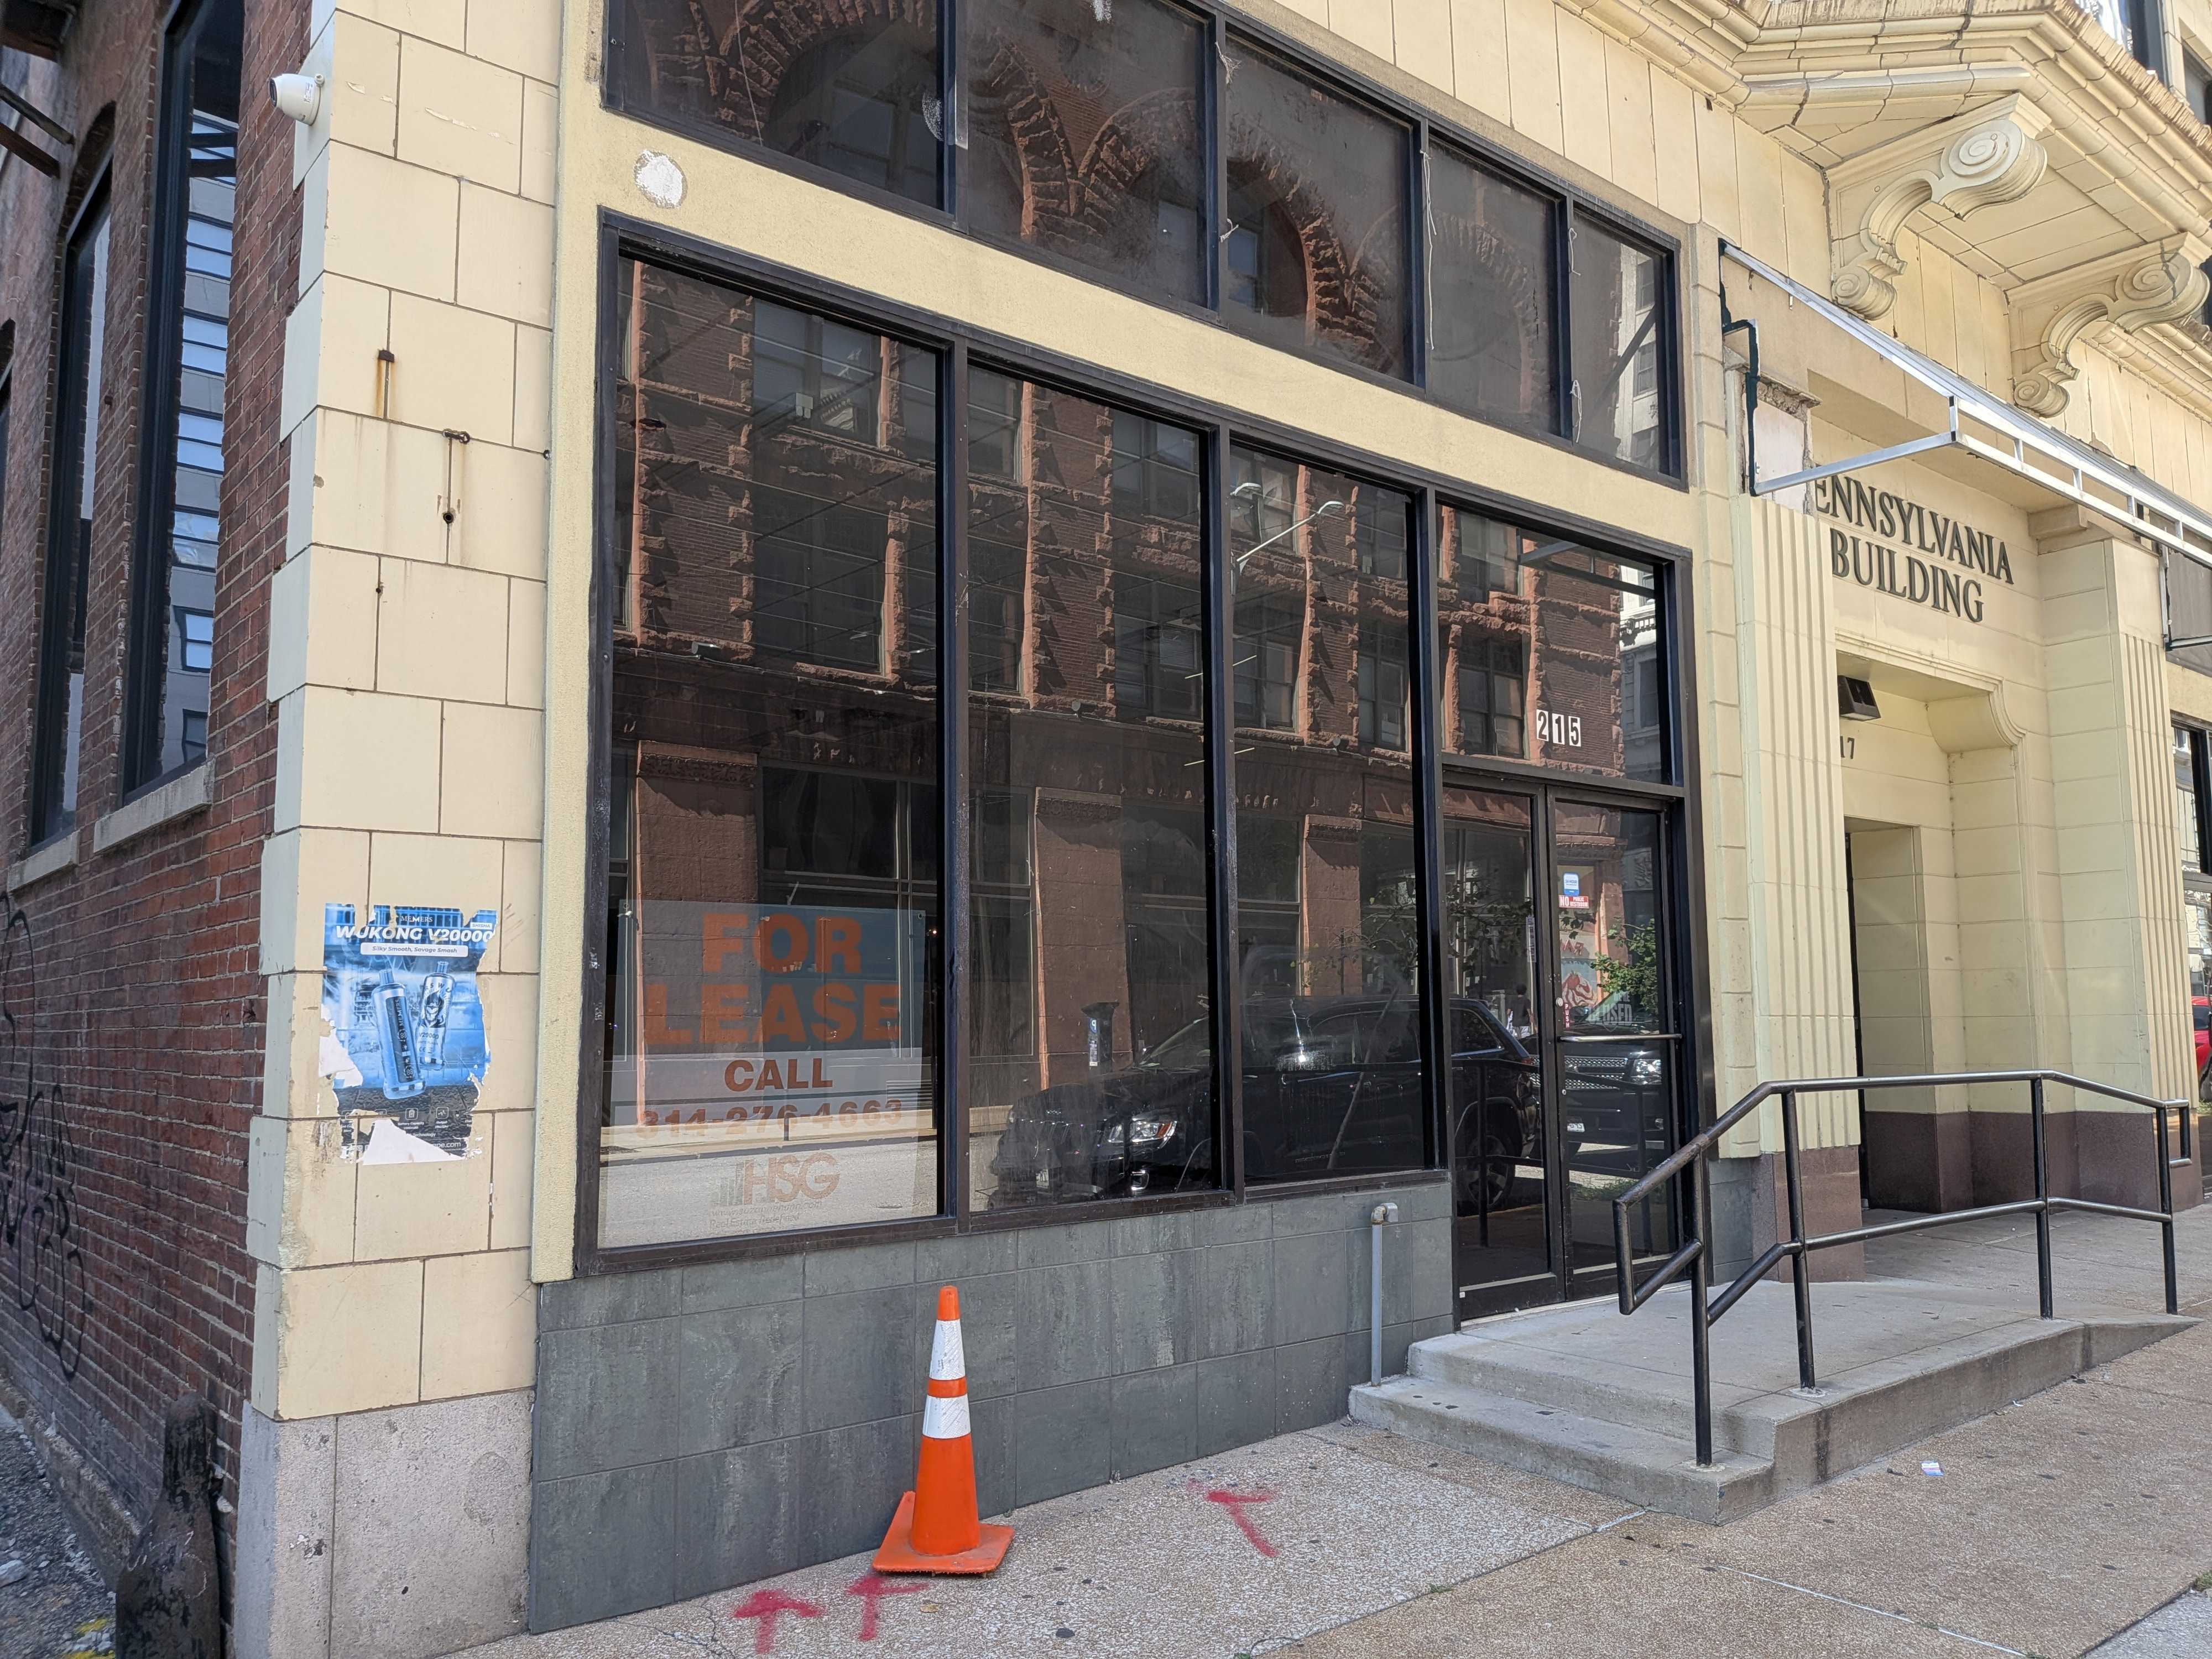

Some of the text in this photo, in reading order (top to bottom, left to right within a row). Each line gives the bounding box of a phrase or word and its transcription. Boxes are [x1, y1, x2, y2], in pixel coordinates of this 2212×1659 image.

[1814, 465, 2014, 585] ENNSYLVANIA
[1829, 528, 1984, 623] BUILDING
[1537, 711, 1579, 745] 215
[1560, 896, 1569, 907] NO
[336, 925, 493, 942] WUKONG V20000
[703, 912, 863, 974] FOR
[644, 983, 902, 1046] LEASE
[724, 1057, 833, 1092] CALL
[635, 1099, 902, 1140] 314-276-4663
[743, 1151, 841, 1206] HSG
